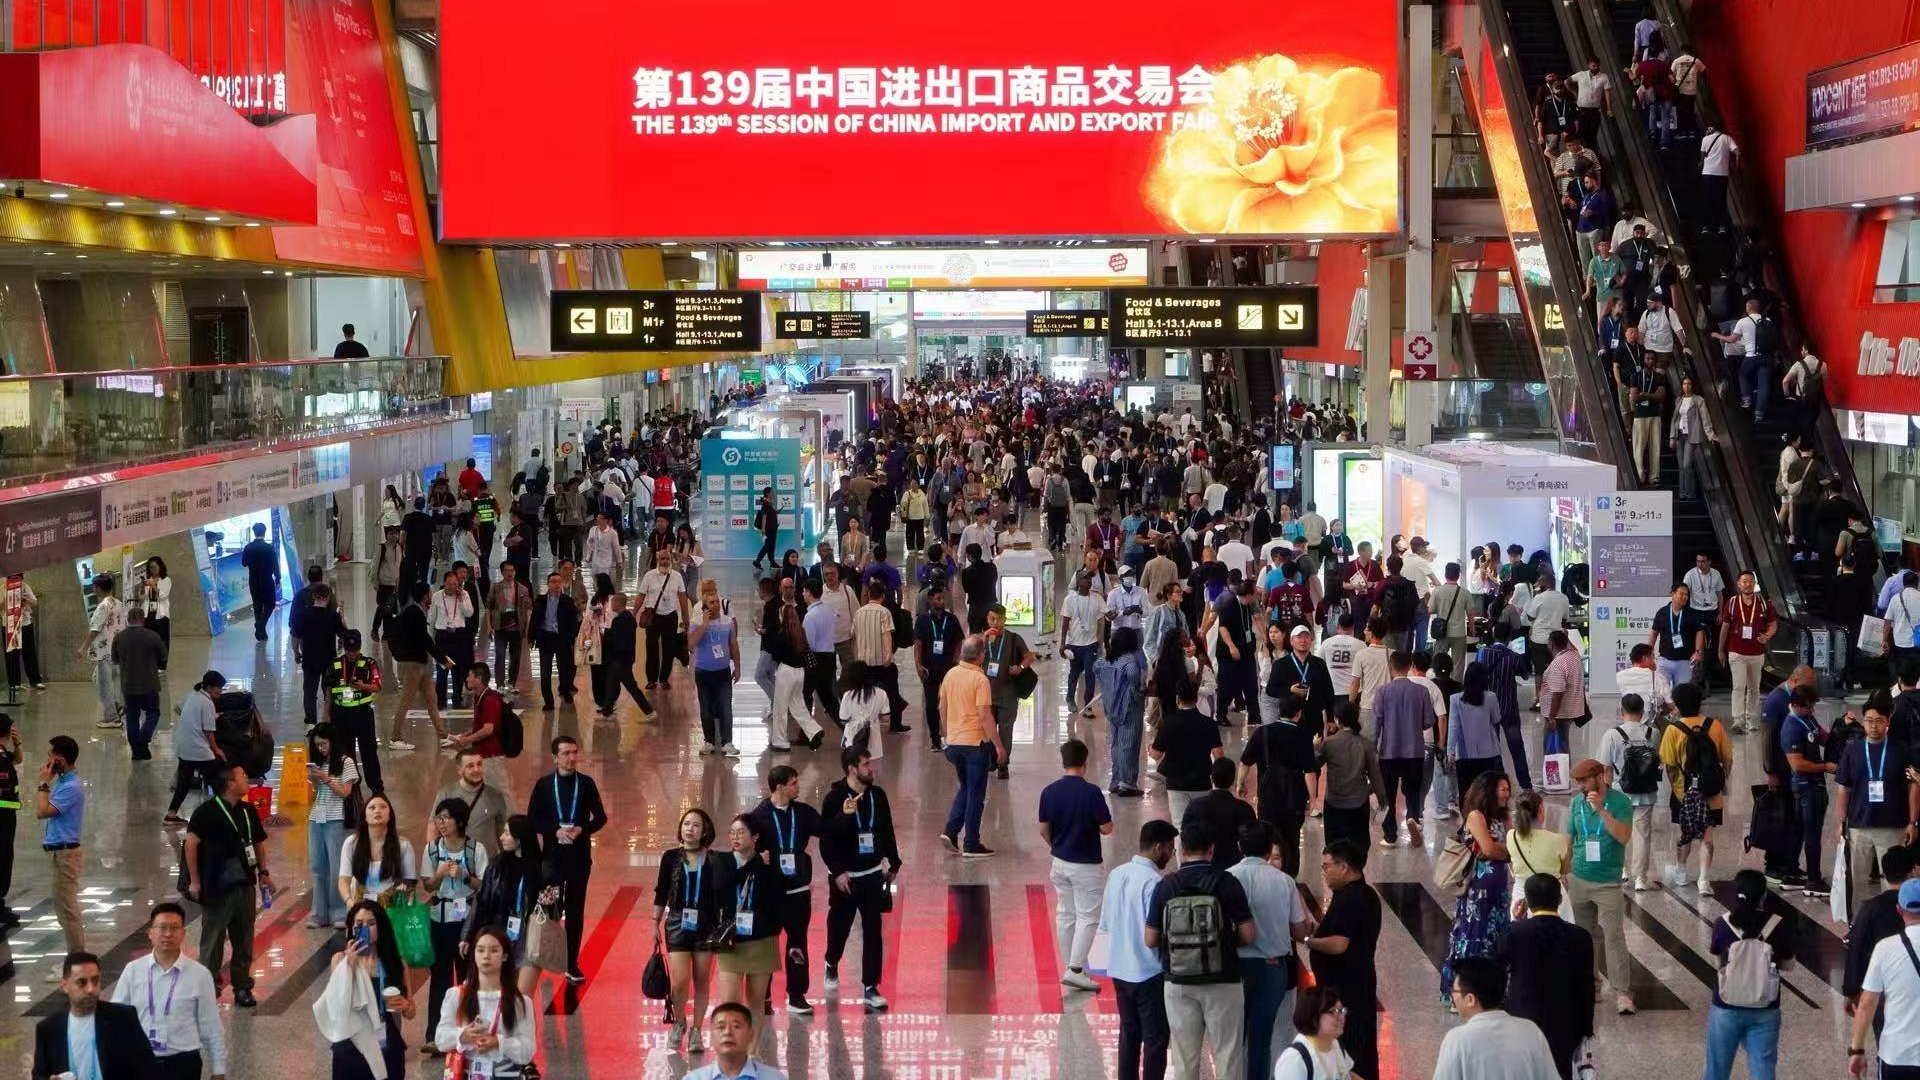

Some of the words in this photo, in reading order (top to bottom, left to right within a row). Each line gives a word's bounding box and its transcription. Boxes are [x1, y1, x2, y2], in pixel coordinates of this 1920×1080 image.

[631, 64, 1215, 109] 第139届中国进出口商品交易会
[632, 115, 675, 134] THE
[681, 113, 732, 134] 139th
[737, 114, 828, 133] SESSION
[835, 114, 863, 133] OF
[869, 114, 936, 133] CHINA
[942, 113, 1025, 132] IMPORT
[1029, 113, 1075, 132] AND
[1082, 112, 1166, 132] EXPORT
[1172, 112, 1218, 131] FAIR
[643, 300, 655, 310] 3F
[1125, 298, 1152, 307] Food
[1154, 298, 1163, 307] &
[1165, 298, 1221, 308] Beverages
[1126, 308, 1151, 316] 餐饮区
[643, 317, 665, 327] M1F
[702, 314, 742, 322] Beverages
[1125, 319, 1145, 328] Hall
[1214, 319, 1222, 328] B
[643, 334, 655, 344] 1F
[1615, 496, 1627, 507] 3F
[1600, 548, 1612, 559] 2F
[1616, 640, 1628, 649] 1F
